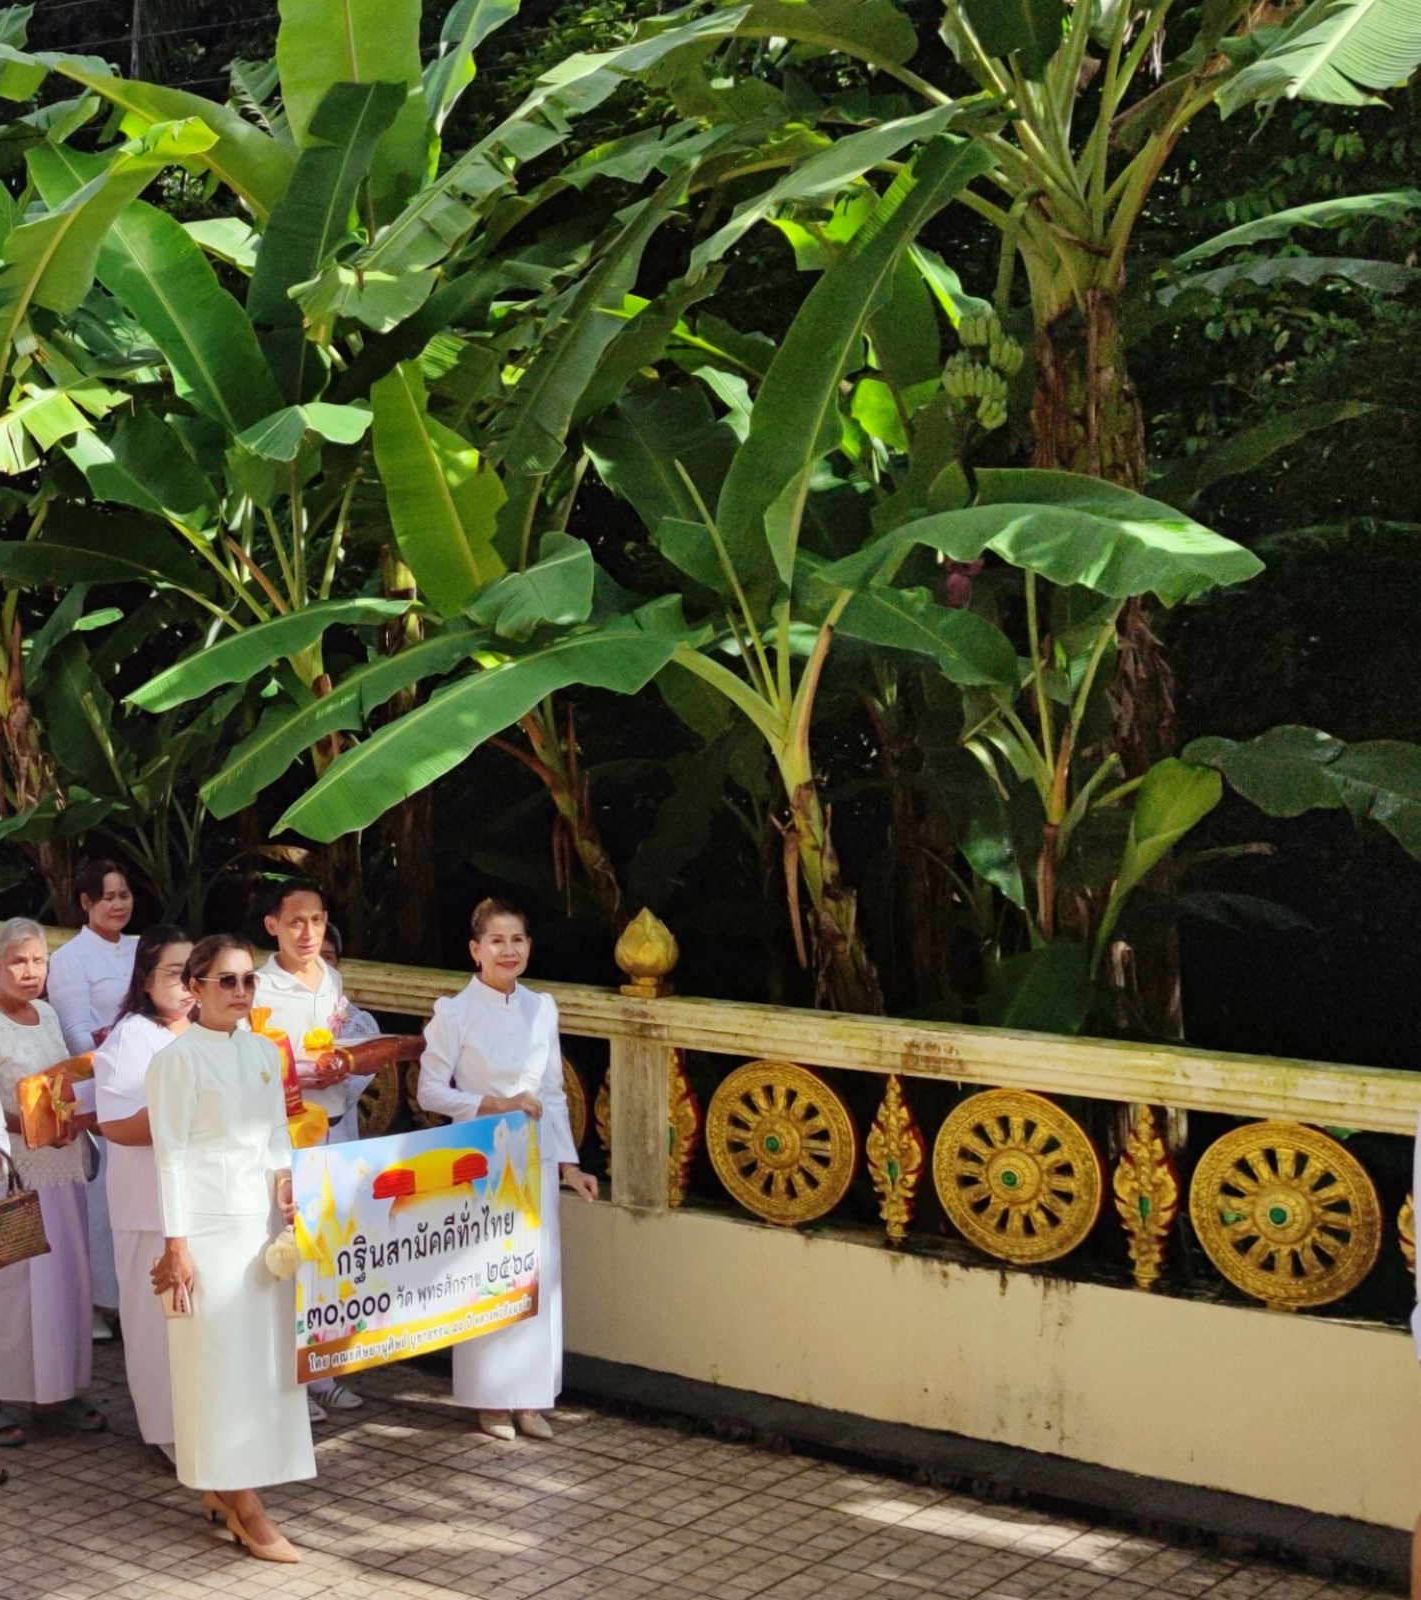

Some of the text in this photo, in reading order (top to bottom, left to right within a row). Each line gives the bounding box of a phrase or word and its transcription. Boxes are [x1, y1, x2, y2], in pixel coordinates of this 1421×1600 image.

[337, 1202, 515, 1285] กฐินสามัคคีทั่วไทย
[307, 1249, 535, 1330] ๓๐,๐๐๐ วัด พุทธศักราช ๒๕๖๘
[309, 1351, 329, 1372] โดย
